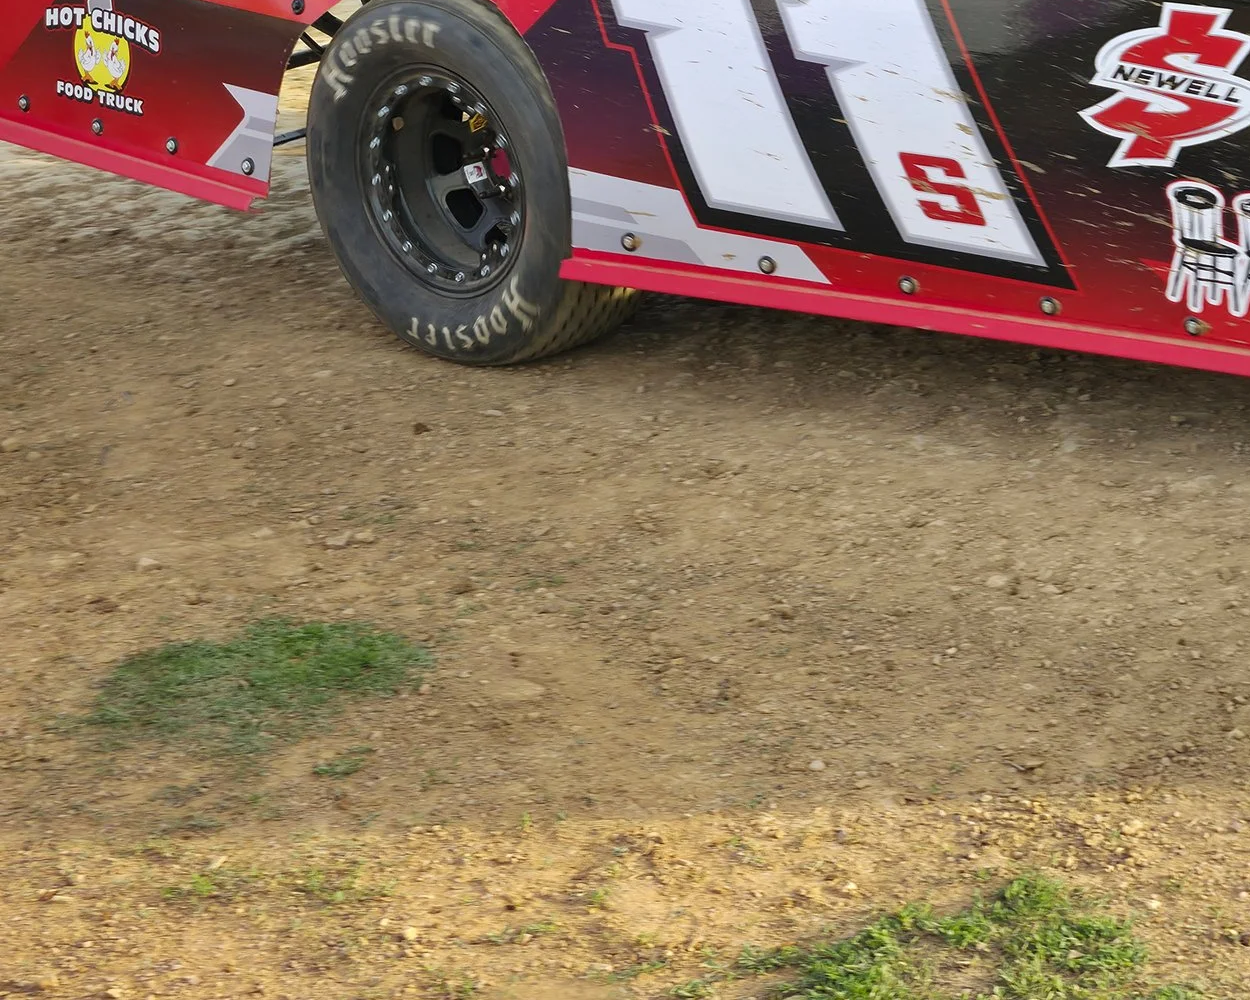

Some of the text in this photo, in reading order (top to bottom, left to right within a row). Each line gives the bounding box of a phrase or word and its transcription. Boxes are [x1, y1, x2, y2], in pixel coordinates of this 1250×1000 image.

[45, 7, 160, 53] HOT CHICKS
[56, 80, 144, 114] FOOD TRUCK
[1112, 64, 1240, 104] NEWELL
